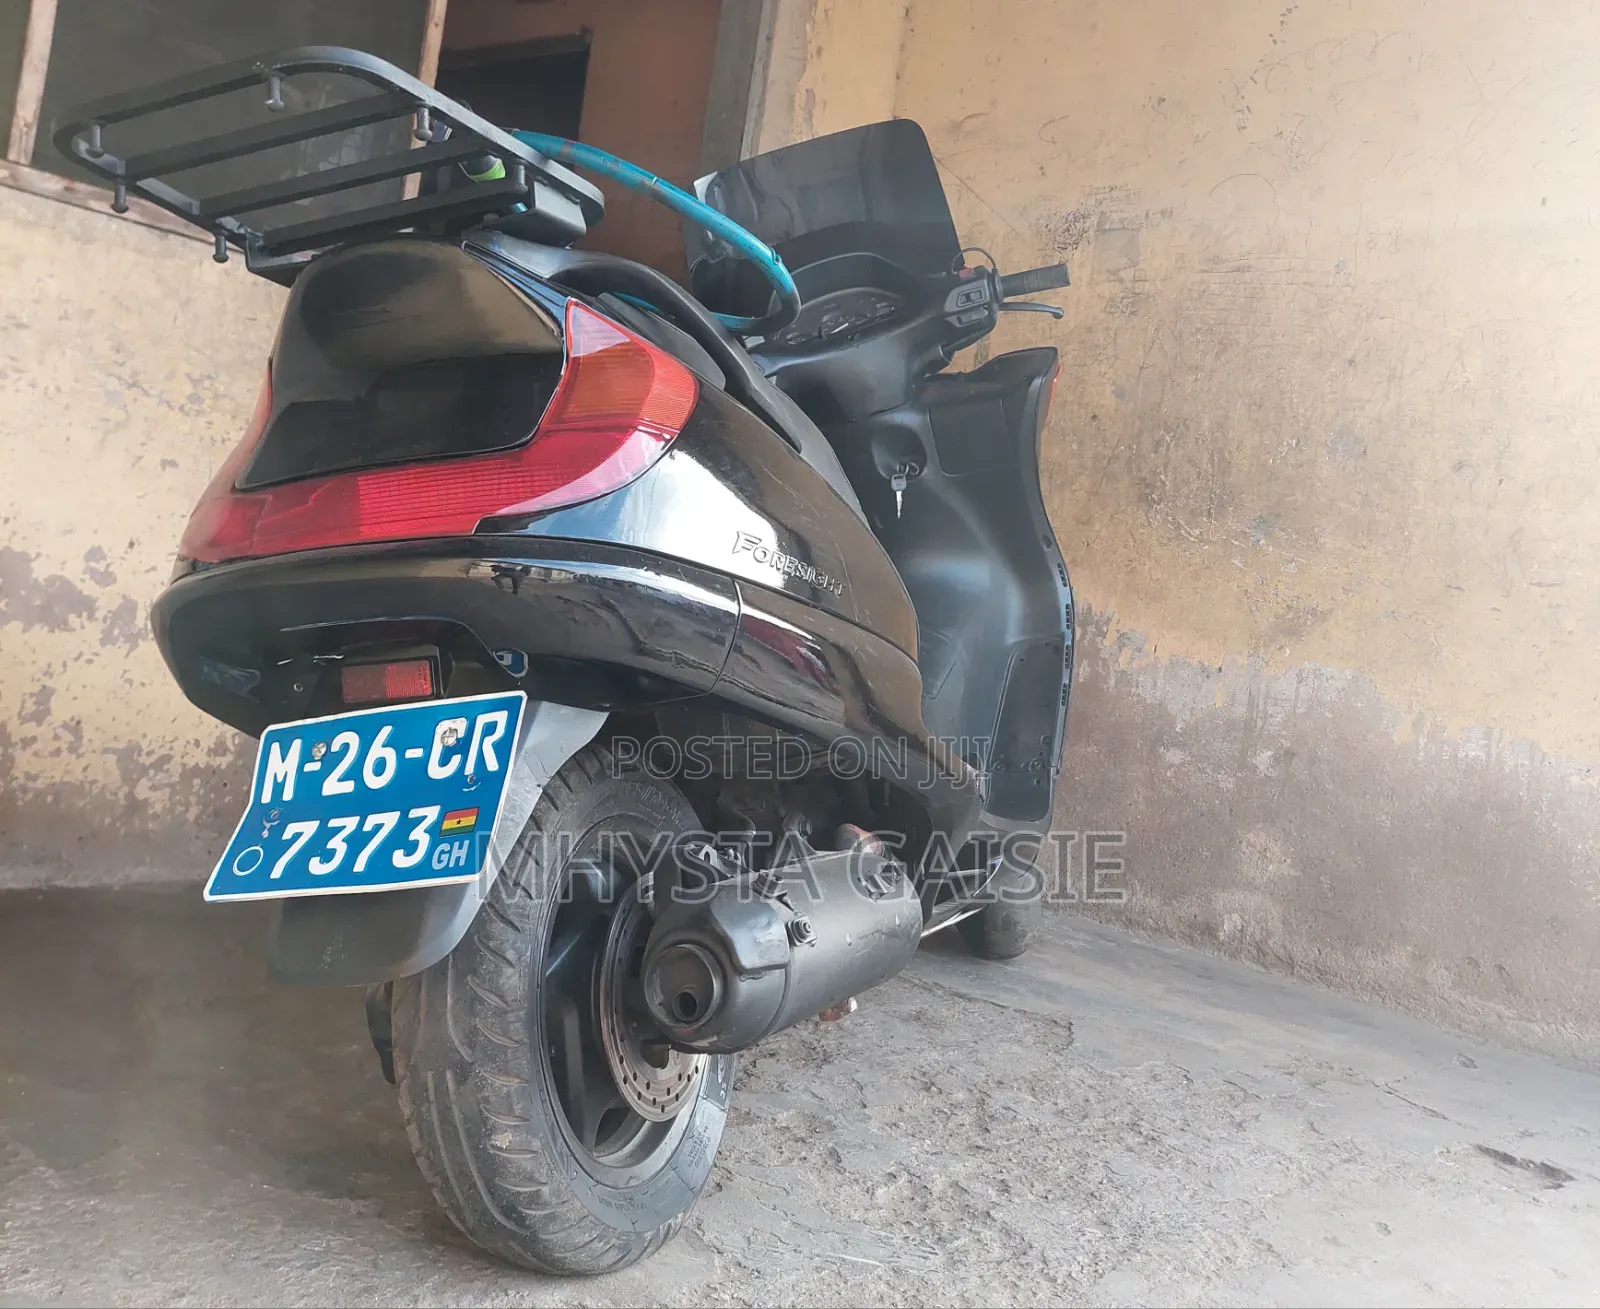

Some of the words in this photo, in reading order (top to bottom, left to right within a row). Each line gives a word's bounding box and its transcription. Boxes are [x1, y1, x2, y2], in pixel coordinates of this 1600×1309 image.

[260, 710, 509, 804] M-26-CR
[269, 804, 441, 880] 7373
[431, 839, 470, 871] GH
